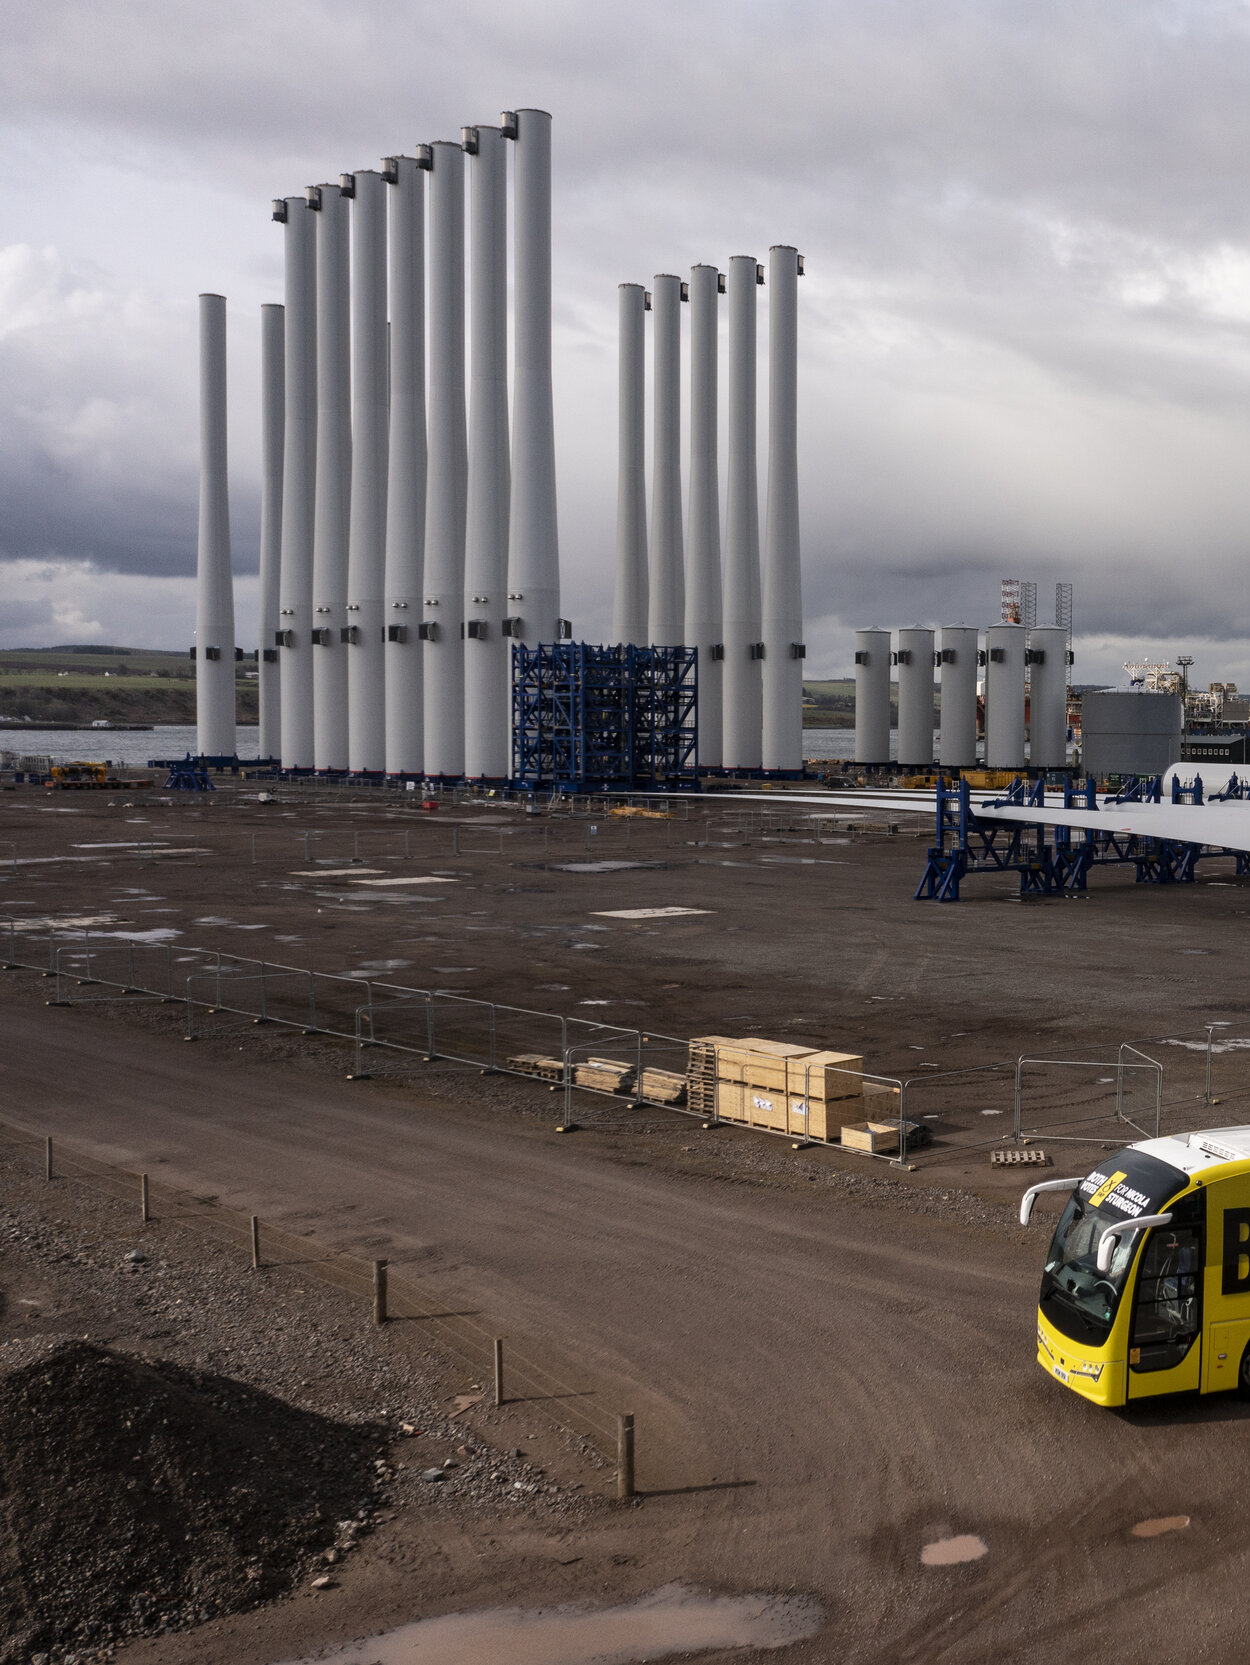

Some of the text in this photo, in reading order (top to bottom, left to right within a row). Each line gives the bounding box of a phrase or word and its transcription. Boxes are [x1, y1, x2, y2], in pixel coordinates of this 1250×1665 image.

[1080, 1181, 1099, 1195] VOTES
[1087, 1171, 1108, 1186] BOTH
[1105, 1192, 1143, 1217] STURGEON
[1113, 1183, 1151, 1208] FOR NICOLA
